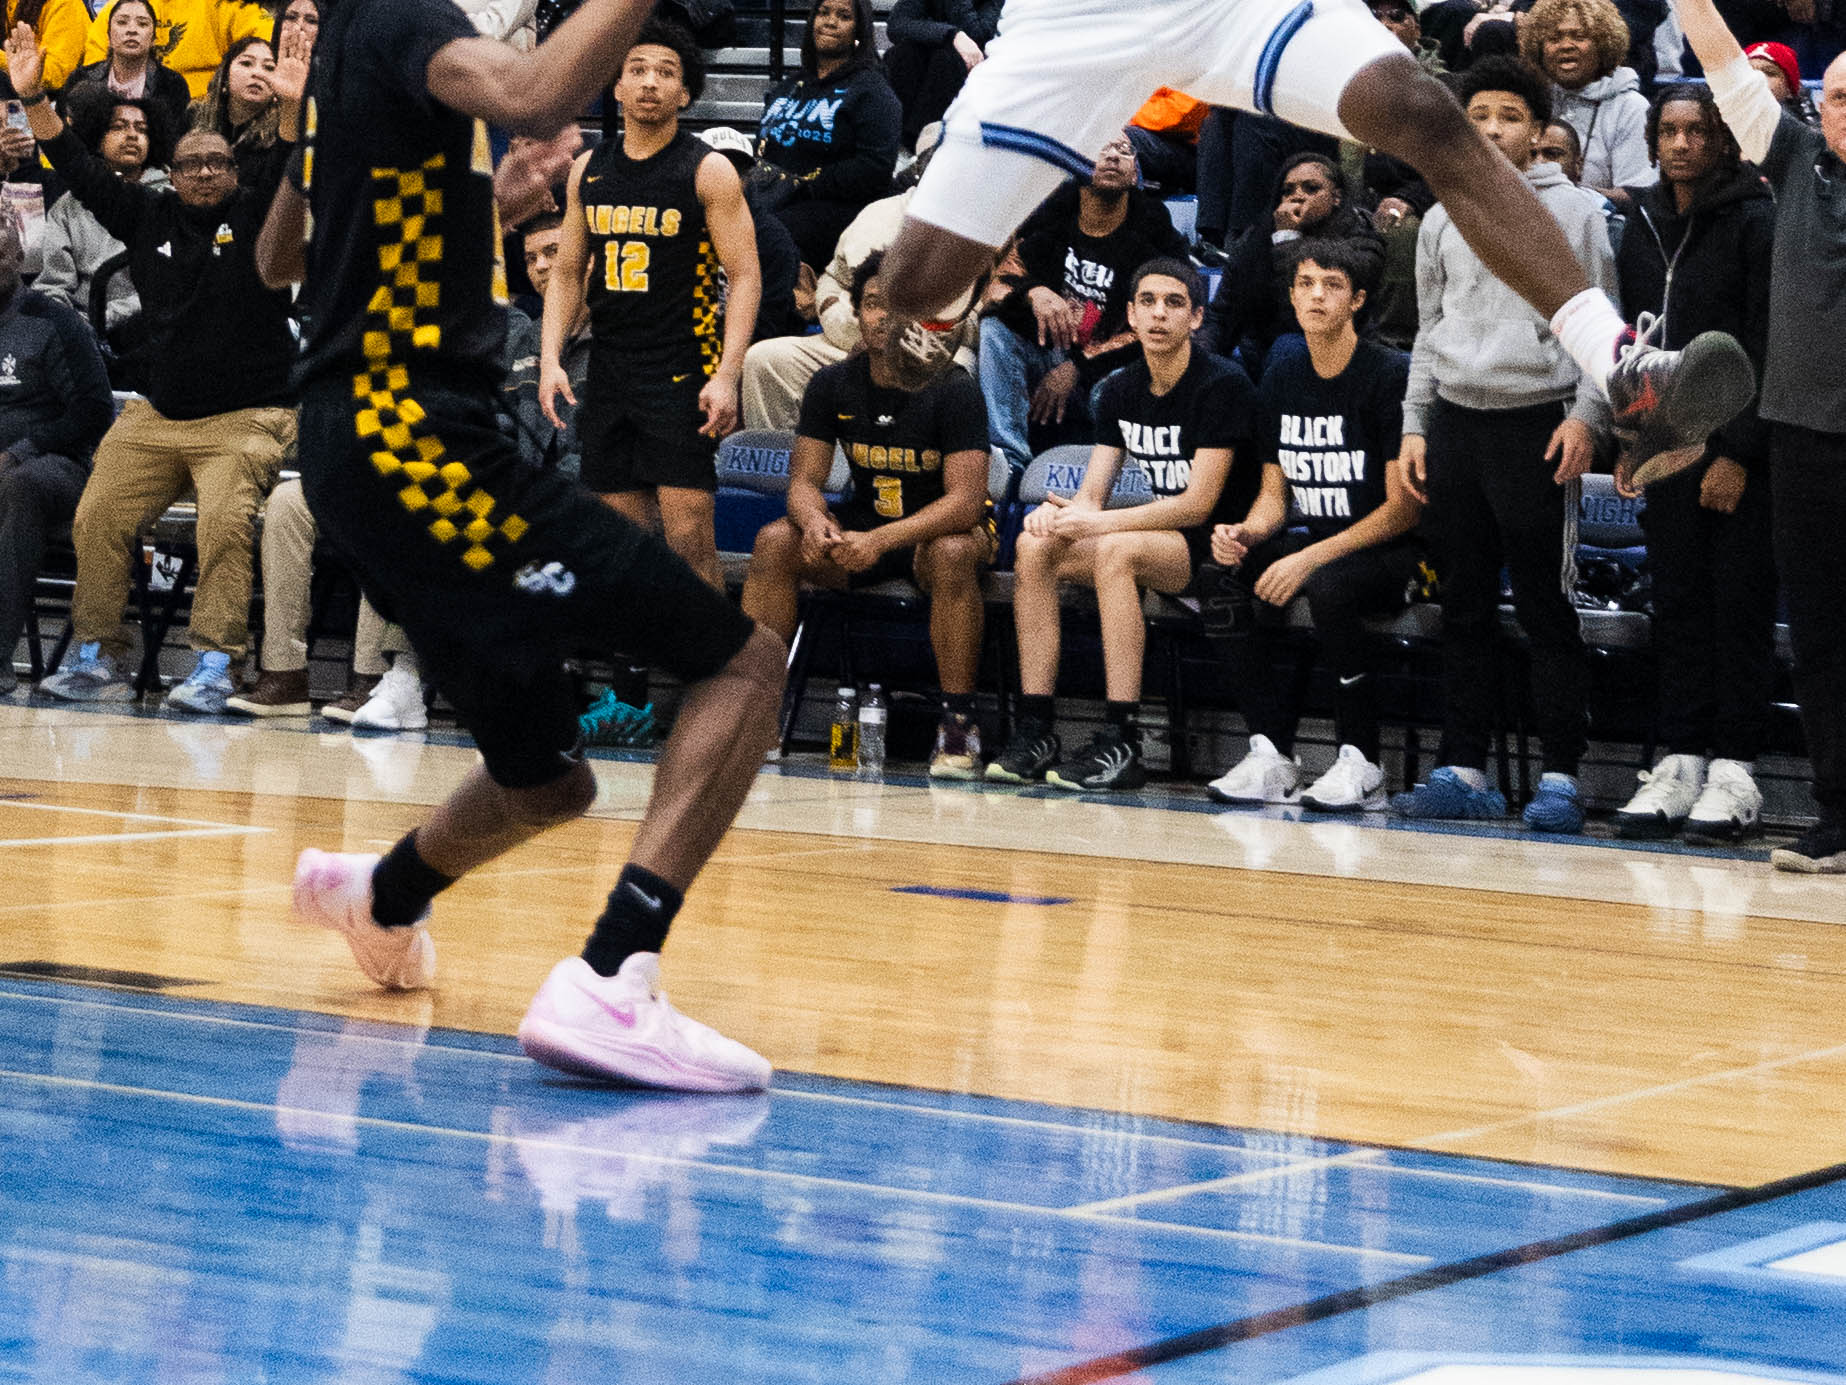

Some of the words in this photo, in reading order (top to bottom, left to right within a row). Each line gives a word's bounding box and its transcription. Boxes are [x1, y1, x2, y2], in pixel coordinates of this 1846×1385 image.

[605, 240, 650, 292] 12
[1280, 414, 1344, 447] BLACK
[728, 445, 790, 475] KNIG
[846, 442, 941, 472] NGELS
[873, 476, 904, 518] 3
[1291, 485, 1352, 517] ONTH
